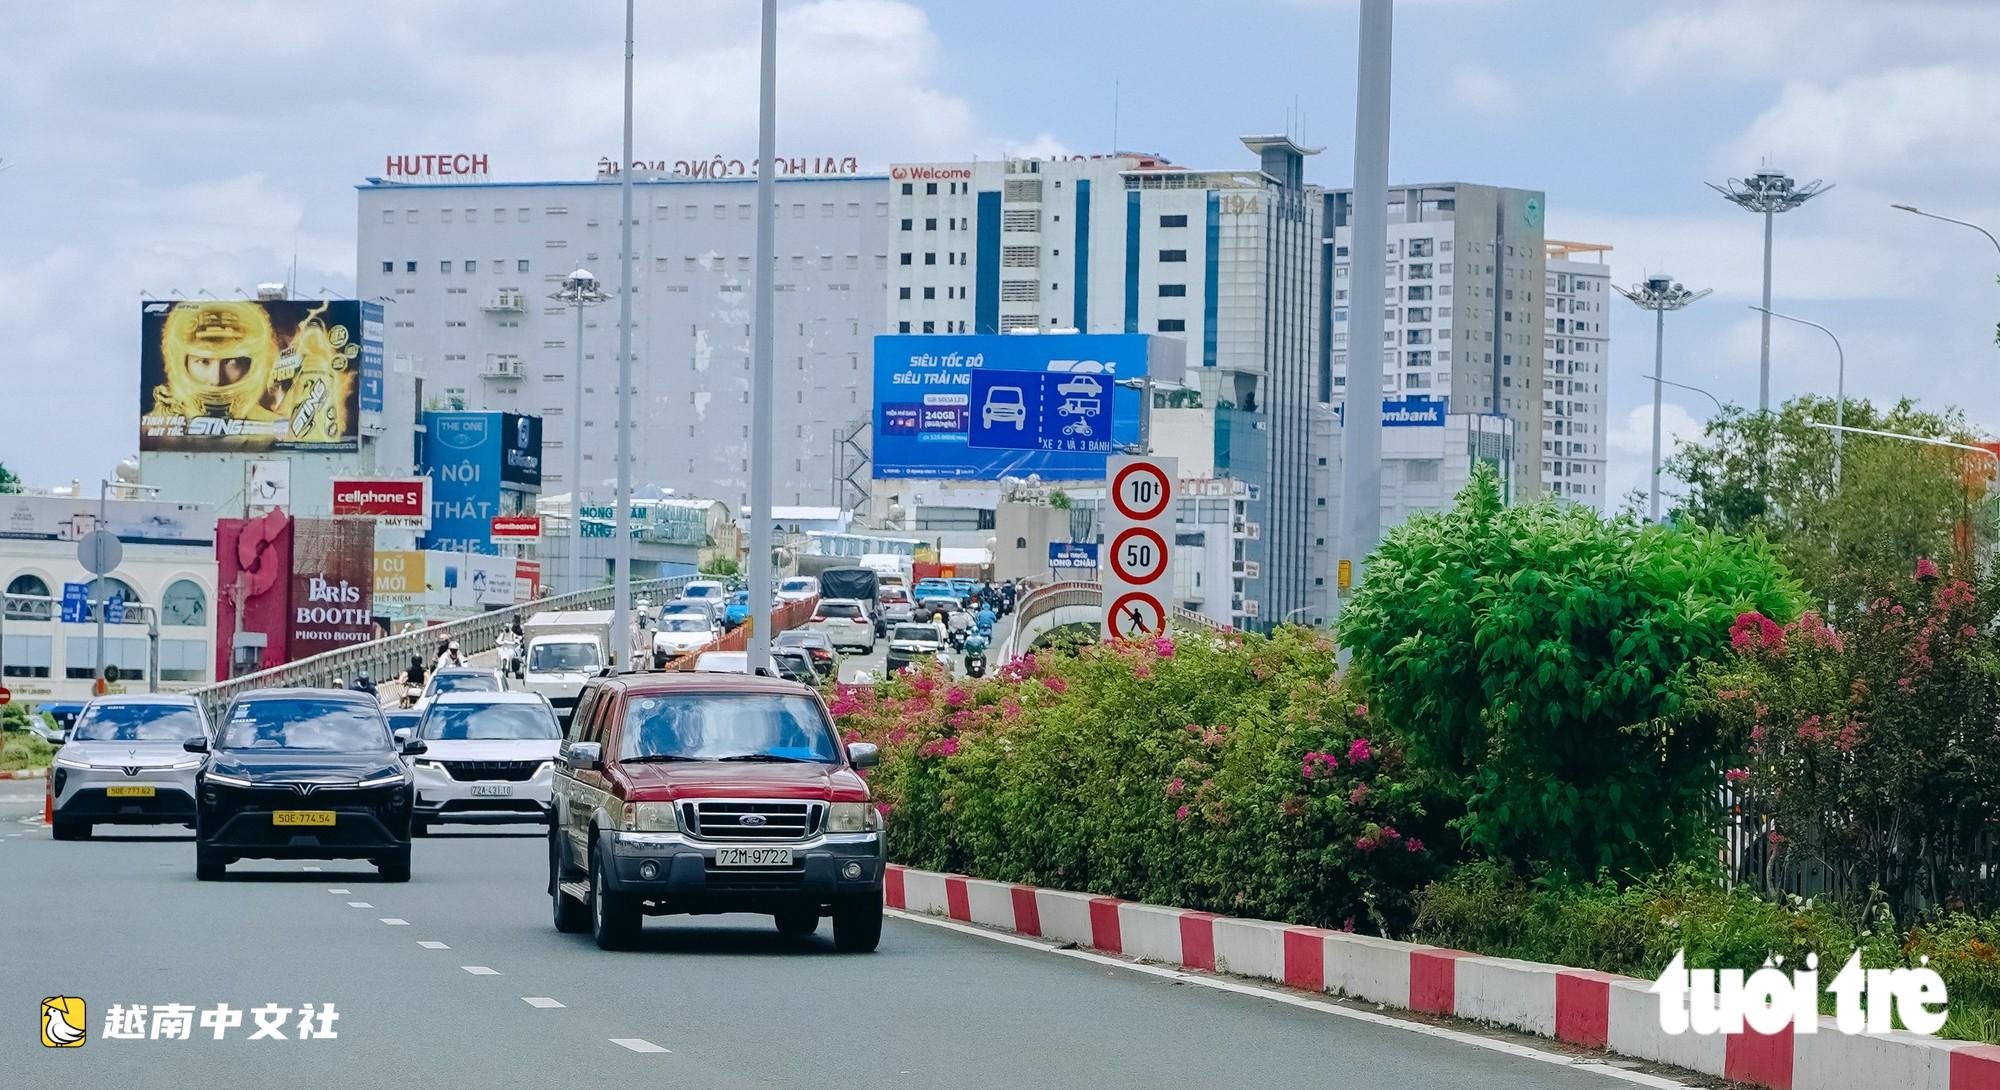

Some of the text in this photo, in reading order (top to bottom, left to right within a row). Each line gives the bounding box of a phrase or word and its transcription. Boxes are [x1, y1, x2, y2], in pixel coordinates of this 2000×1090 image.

[386, 154, 488, 176] HUTECH
[910, 167, 971, 179] Welcome
[1221, 194, 1258, 214] 194
[909, 353, 938, 368] SIÊU
[941, 351, 964, 368] TỐC
[893, 370, 921, 385] SIÊU
[925, 411, 956, 420] 240GB
[442, 422, 483, 431] THE ONE
[1043, 438, 1054, 449] XE
[1057, 439, 1063, 450] 2
[1066, 437, 1076, 450] VÀ
[1080, 440, 1086, 451] 3
[441, 459, 481, 486] NỘI
[433, 495, 491, 519] THẤT
[385, 516, 403, 526] MÁY
[404, 516, 423, 526] TÍNH
[383, 554, 405, 572] CŨ
[1049, 558, 1097, 567] LONG CHÂU
[1127, 544, 1151, 567] 50
[375, 573, 406, 591] MỚI
[296, 606, 371, 625] BOOTH
[295, 630, 371, 641] PHOTO BOOTH
[720, 849, 789, 864] 72M-9722
